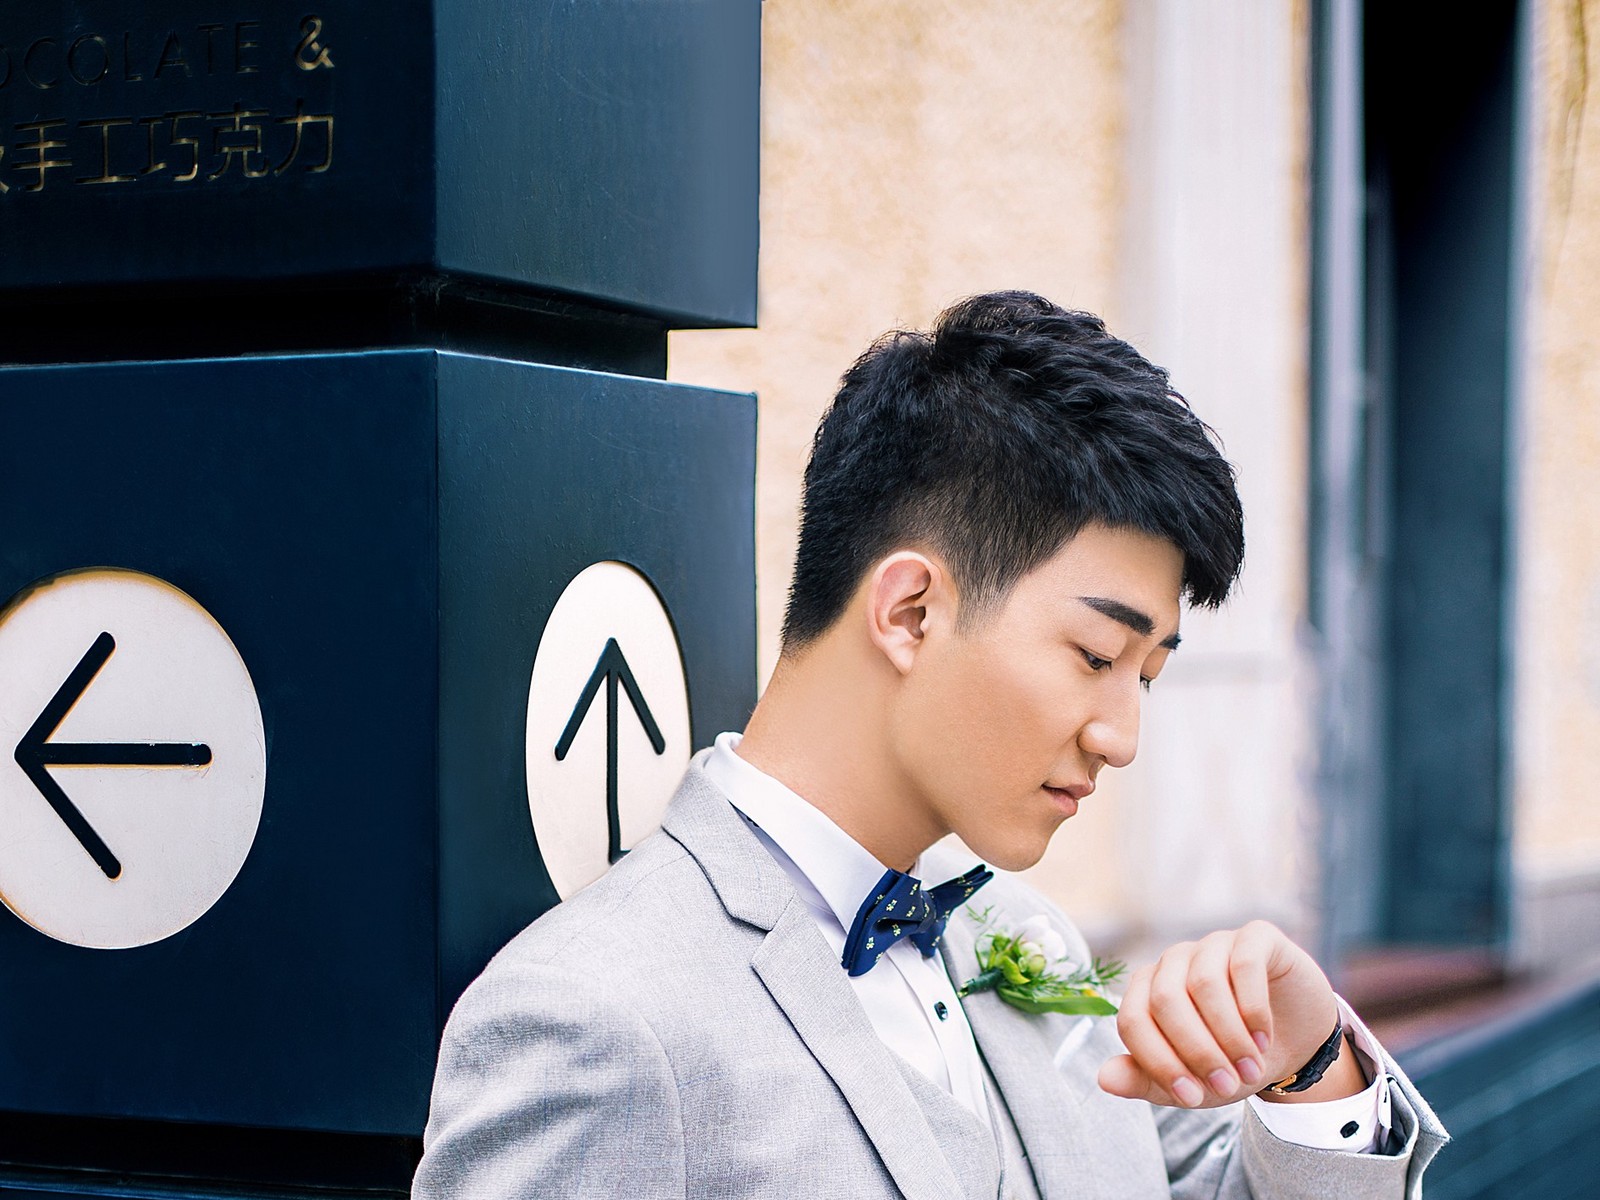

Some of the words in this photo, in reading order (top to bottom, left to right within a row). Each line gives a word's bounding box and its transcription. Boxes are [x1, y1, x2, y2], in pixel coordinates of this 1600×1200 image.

[0, 20, 261, 90] COLATE
[294, 14, 335, 71] &
[0, 97, 334, 194] 手工巧克力
